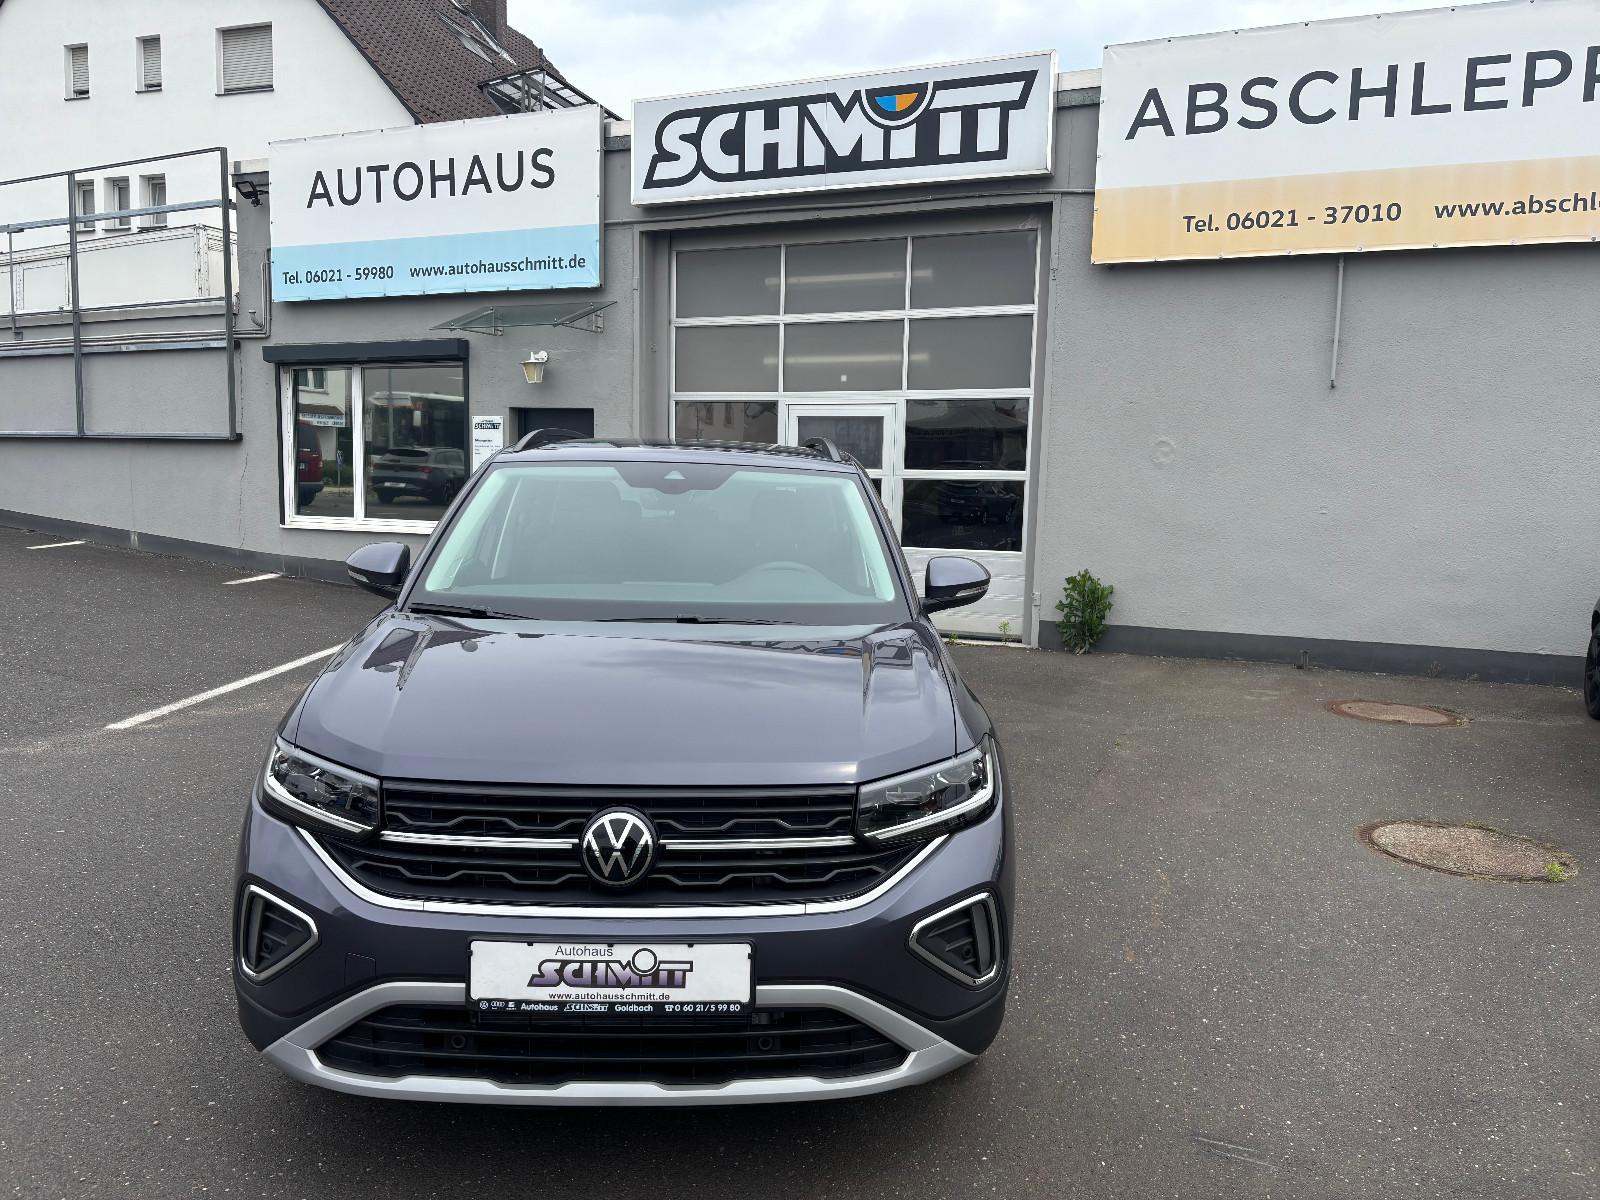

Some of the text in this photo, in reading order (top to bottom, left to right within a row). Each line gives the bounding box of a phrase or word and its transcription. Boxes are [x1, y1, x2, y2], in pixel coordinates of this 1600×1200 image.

[643, 70, 1038, 189] SCHMITT
[306, 147, 556, 209] AUTOHAUS
[1183, 213, 1220, 233] Tel.
[1226, 209, 1299, 231] 06021
[1323, 202, 1402, 225] 37010
[1435, 192, 1600, 219] www.abschl
[282, 269, 302, 285] Tel.
[305, 268, 343, 284] 06021
[354, 265, 394, 281] 59980
[409, 253, 586, 279] www.autohausschmitt.de
[527, 948, 694, 990] SCHMITT
[555, 945, 614, 957] Autohaus
[520, 1002, 559, 1012] Autohaus
[614, 1003, 654, 1012] Goldbach
[682, 1004, 694, 1012] 60
[717, 1004, 728, 1012] 99
[729, 1004, 741, 1012] 80
[548, 992, 670, 1002] www.autohausschmitt.de
